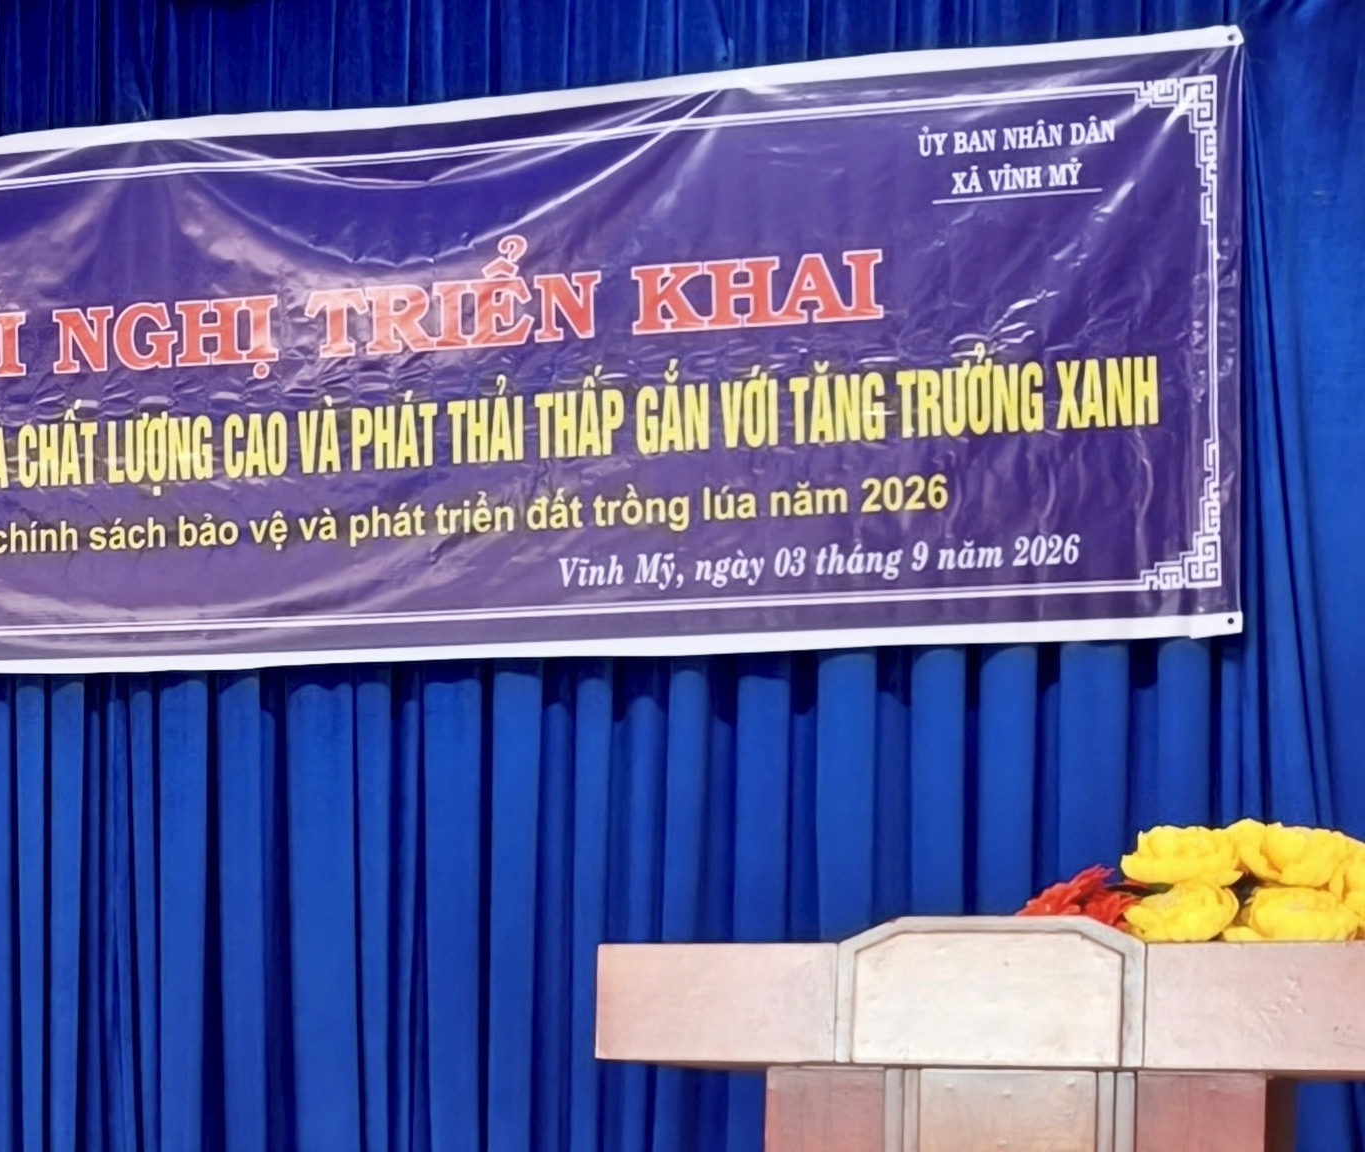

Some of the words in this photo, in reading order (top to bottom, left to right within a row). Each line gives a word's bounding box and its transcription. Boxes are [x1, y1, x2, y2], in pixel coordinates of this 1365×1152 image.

[918, 125, 948, 157] ỦY
[953, 129, 997, 154] BAN
[1003, 119, 1063, 150] NHÂN
[1070, 115, 1116, 145] DÂN
[52, 294, 279, 378] NGHỊ
[304, 235, 601, 359] TRIỂN
[631, 248, 884, 335] KHAI
[18, 399, 98, 488] CHẤT
[108, 411, 213, 496] LƯỢNG
[223, 410, 288, 478] CAO
[298, 394, 341, 473] VÀ
[351, 389, 438, 471] PHÁT
[447, 374, 524, 465] THẢI
[535, 364, 625, 458] THẤP
[636, 358, 710, 455] GẮN
[721, 365, 779, 449] VỚI
[790, 360, 886, 445] TĂNG
[896, 342, 1043, 438] TRƯỞNG
[1056, 355, 1159, 430] XANH
[89, 517, 166, 551] sách
[178, 513, 239, 548] bảo
[250, 513, 288, 549] vệ
[299, 509, 337, 540] và
[350, 502, 425, 546] phát
[434, 491, 515, 535] triển
[526, 488, 582, 531] đất
[593, 483, 690, 531] trồng
[703, 486, 757, 521] lúa
[769, 482, 848, 518] năm
[860, 474, 948, 513] 2026
[558, 554, 624, 588] Vĩnh
[634, 551, 684, 591] Mỹ,
[694, 548, 765, 588] ngày
[774, 546, 806, 578] 03
[815, 543, 903, 580] tháng
[911, 541, 928, 571] 9
[937, 539, 1003, 570] năm
[1012, 534, 1081, 566] 2026
